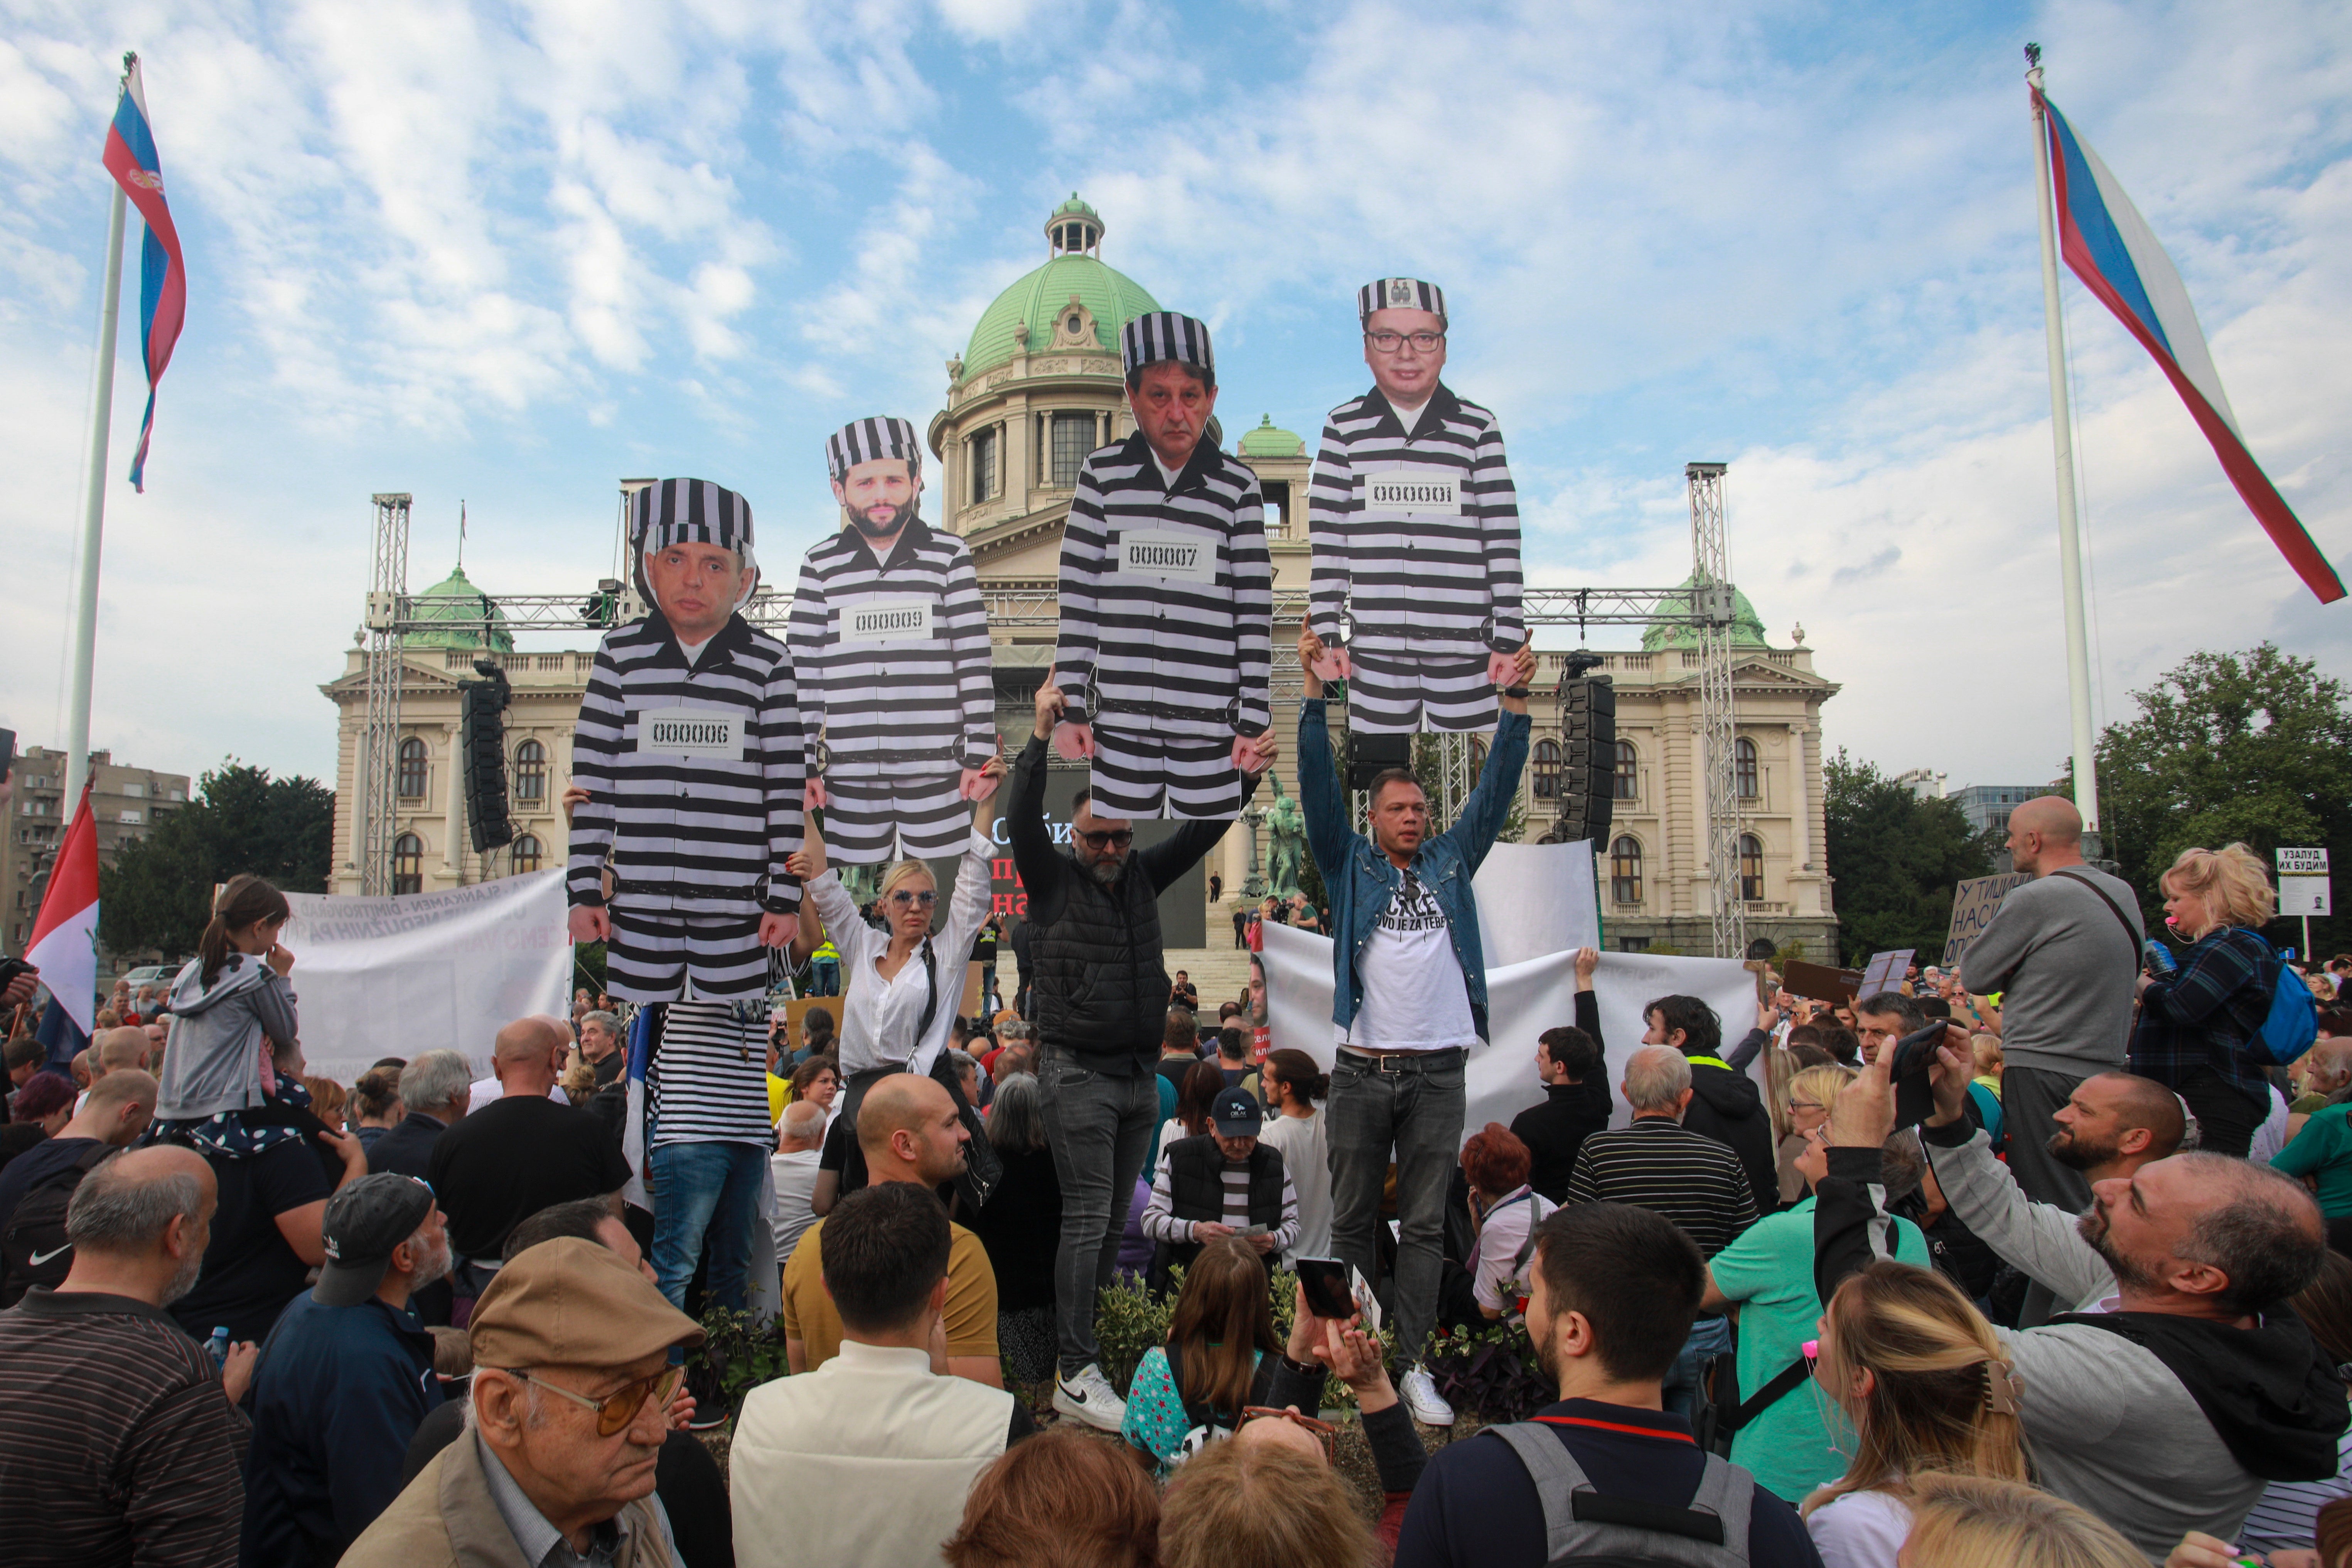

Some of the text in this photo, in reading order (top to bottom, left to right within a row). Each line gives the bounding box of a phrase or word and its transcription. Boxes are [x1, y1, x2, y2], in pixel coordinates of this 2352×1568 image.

[1374, 486, 1452, 502] 000001
[1130, 545, 1197, 566] 000007
[856, 611, 922, 631] 000009
[653, 723, 728, 744] 000006
[2283, 850, 2320, 860] УЗАЛУД
[2278, 861, 2327, 871] ИХ БУДИМ
[1958, 883, 1973, 905] У
[1396, 917, 1407, 931] JE
[1409, 917, 1422, 931] ZA
[1424, 916, 1446, 930] TEBE
